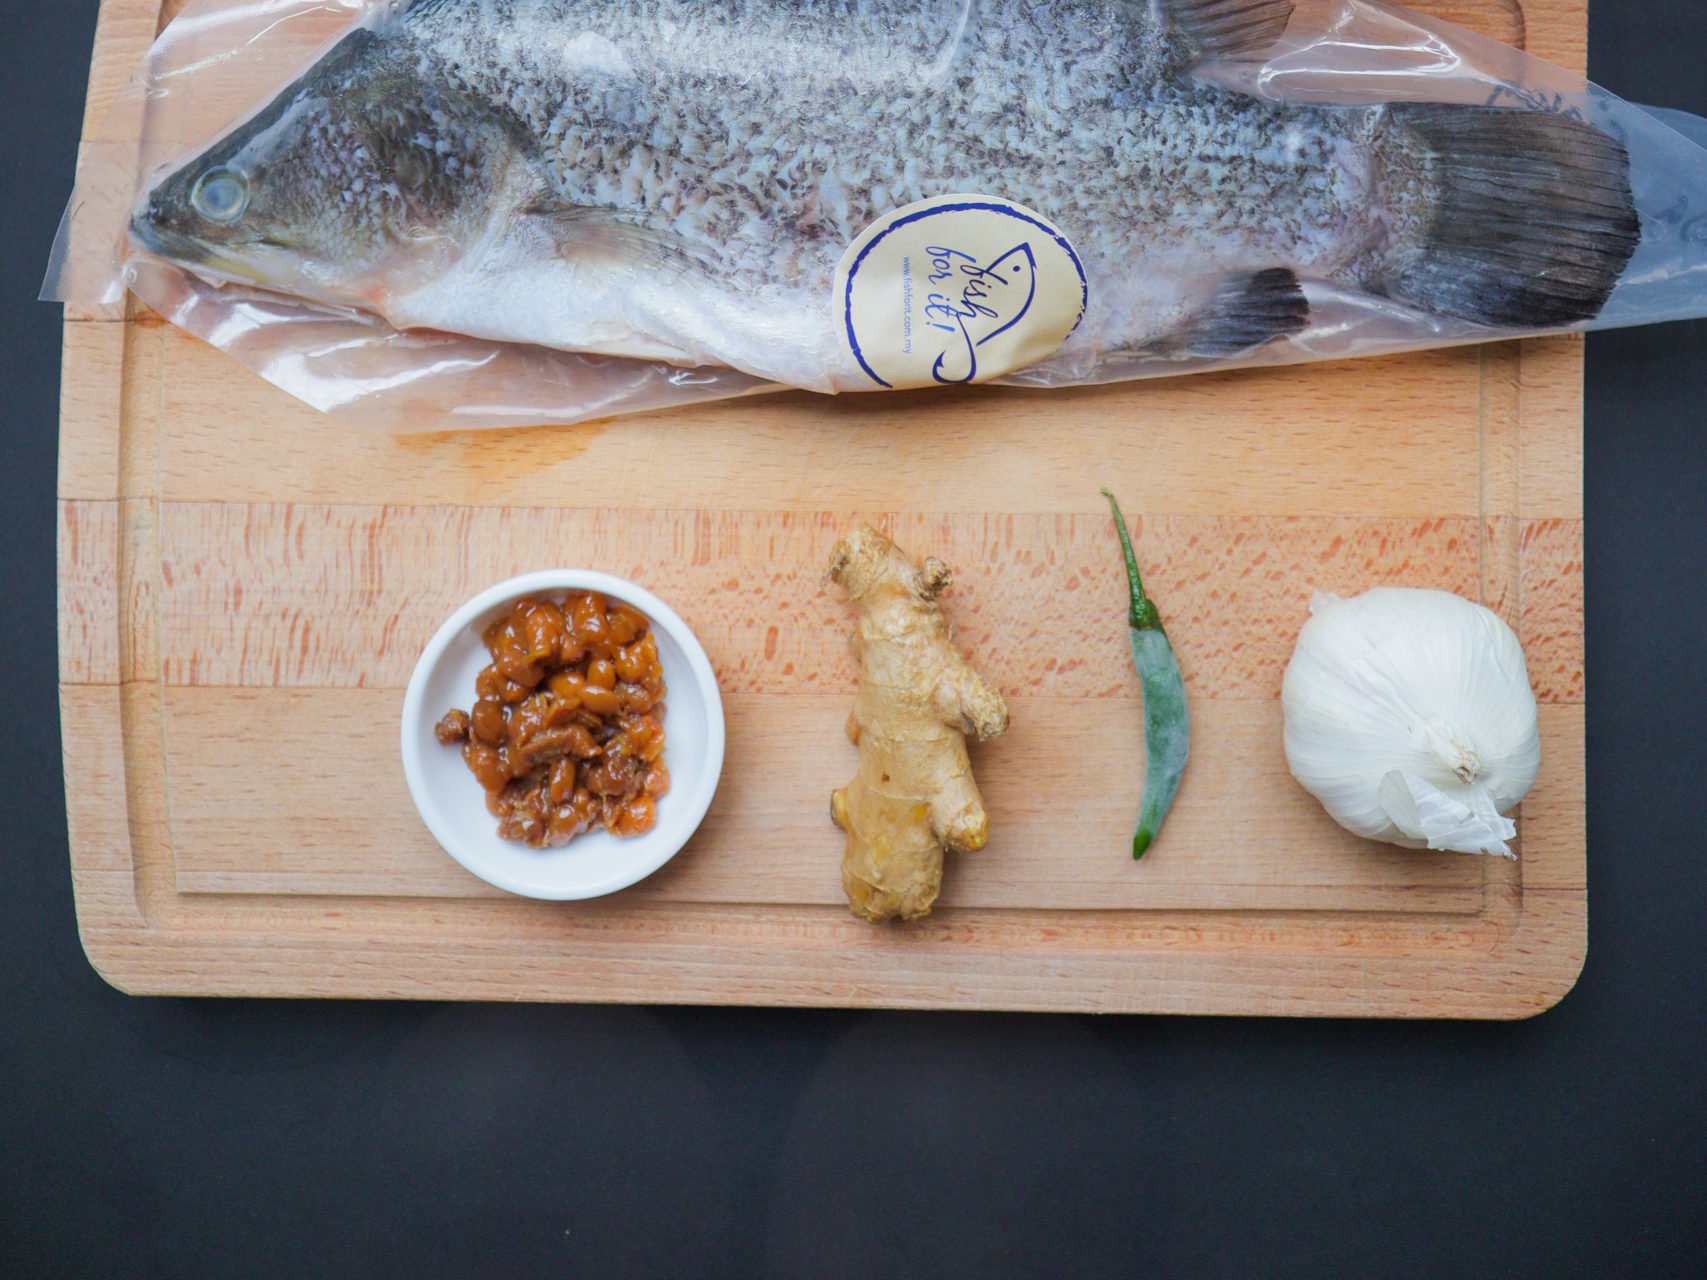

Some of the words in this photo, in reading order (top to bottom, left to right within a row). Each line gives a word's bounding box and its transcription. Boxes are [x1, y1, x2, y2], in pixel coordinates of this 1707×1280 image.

[925, 246, 977, 284] for
[902, 256, 914, 354] www.fishforit.com.my
[925, 293, 957, 333] it!
[960, 264, 1009, 319] fish
